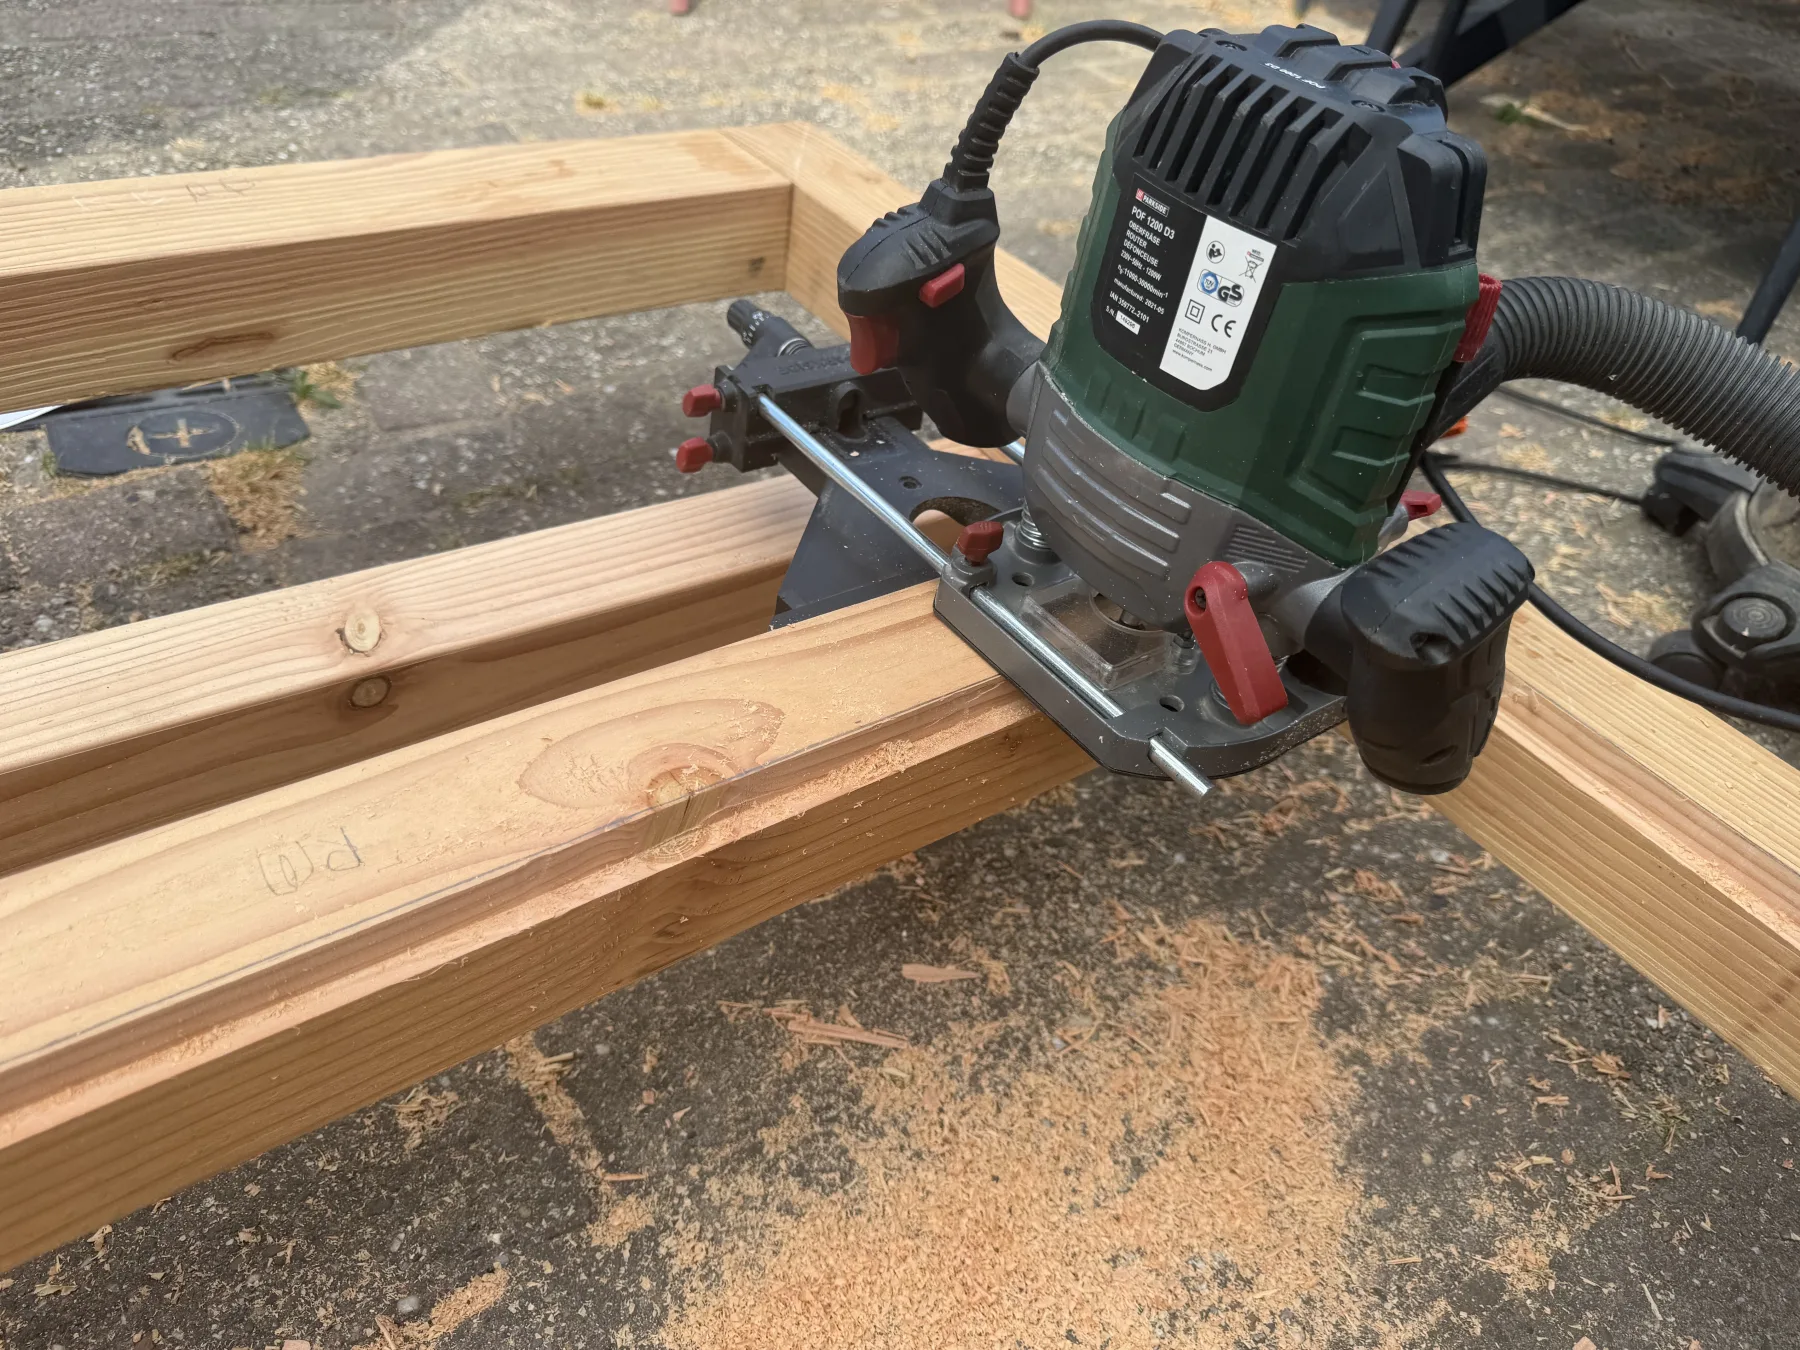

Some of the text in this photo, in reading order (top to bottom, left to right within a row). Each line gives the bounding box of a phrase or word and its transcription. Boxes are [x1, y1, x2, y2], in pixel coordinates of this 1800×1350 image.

[1142, 194, 1167, 215] PARKSIDE
[1128, 220, 1161, 246] OBERFRÄSE
[1131, 205, 1175, 240] POF 1200 D3
[1126, 229, 1148, 249] ROUTER
[1109, 291, 1119, 302] IAN
[1113, 277, 1144, 303] manufactured:
[1217, 284, 1243, 303] GS
[1211, 314, 1237, 339] CE
